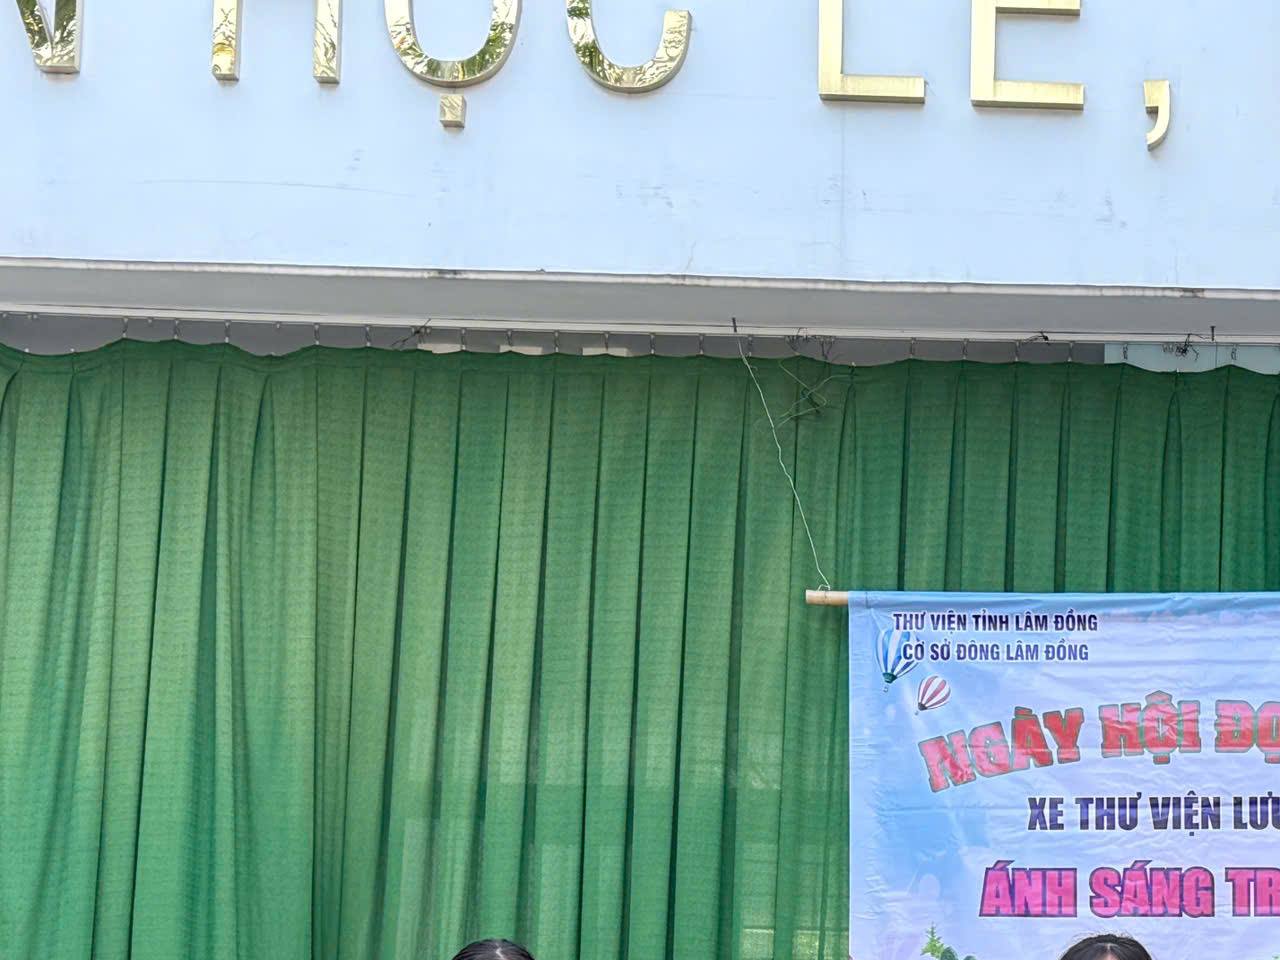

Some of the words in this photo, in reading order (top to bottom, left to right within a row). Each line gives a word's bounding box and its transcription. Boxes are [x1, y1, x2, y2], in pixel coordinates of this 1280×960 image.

[893, 611, 926, 630] THƯ
[930, 610, 966, 634] VIỆN
[972, 609, 1009, 631] TỈNH
[1015, 611, 1048, 631] LÂM
[1053, 609, 1098, 631] ĐỒNG
[930, 638, 951, 661] SỞ
[956, 640, 1000, 661] ĐÔNG
[1006, 640, 1039, 661] LÂM
[1044, 638, 1088, 661] ĐỒNG
[918, 706, 1084, 793] NGÀY
[1098, 690, 1202, 765] HỘI
[1028, 797, 1064, 830] XE
[1075, 792, 1142, 830] THƯ
[1150, 791, 1221, 836] VIỆN
[979, 860, 1077, 917] ÁNH
[1089, 860, 1215, 918] SÁNG
